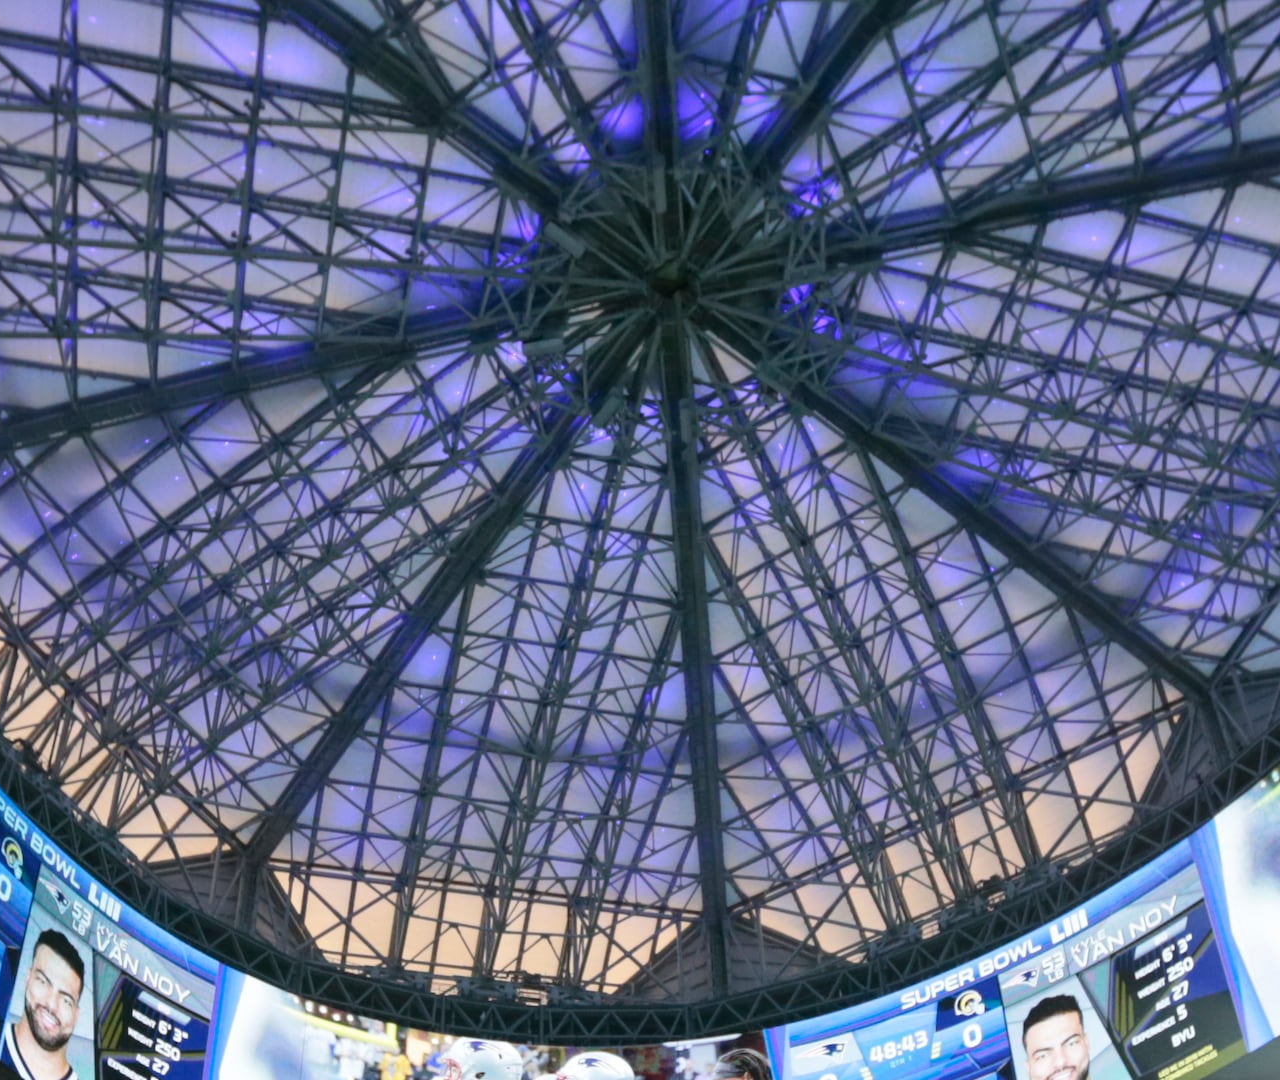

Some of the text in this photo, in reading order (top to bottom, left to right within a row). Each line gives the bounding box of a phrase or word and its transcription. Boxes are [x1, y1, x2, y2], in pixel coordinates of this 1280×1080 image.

[29, 835, 81, 890] BOWL
[87, 882, 123, 923] LIII
[70, 902, 94, 928] 53
[96, 922, 128, 950] KYLE
[1071, 894, 1177, 969] VAN NOY
[1071, 930, 1106, 954] KYLE
[96, 931, 192, 1004] VAN NOY
[900, 908, 1089, 1010] SUPER BOWL LIII
[1042, 951, 1066, 975] 53
[1166, 956, 1194, 983] 250
[1172, 980, 1189, 1002] 27
[1176, 1003, 1188, 1021] 5
[870, 1030, 929, 1063] 48:43
[963, 1023, 983, 1048] 0
[1170, 1025, 1196, 1048] BYU
[155, 1037, 181, 1062] 250
[152, 1057, 170, 1076] 27
